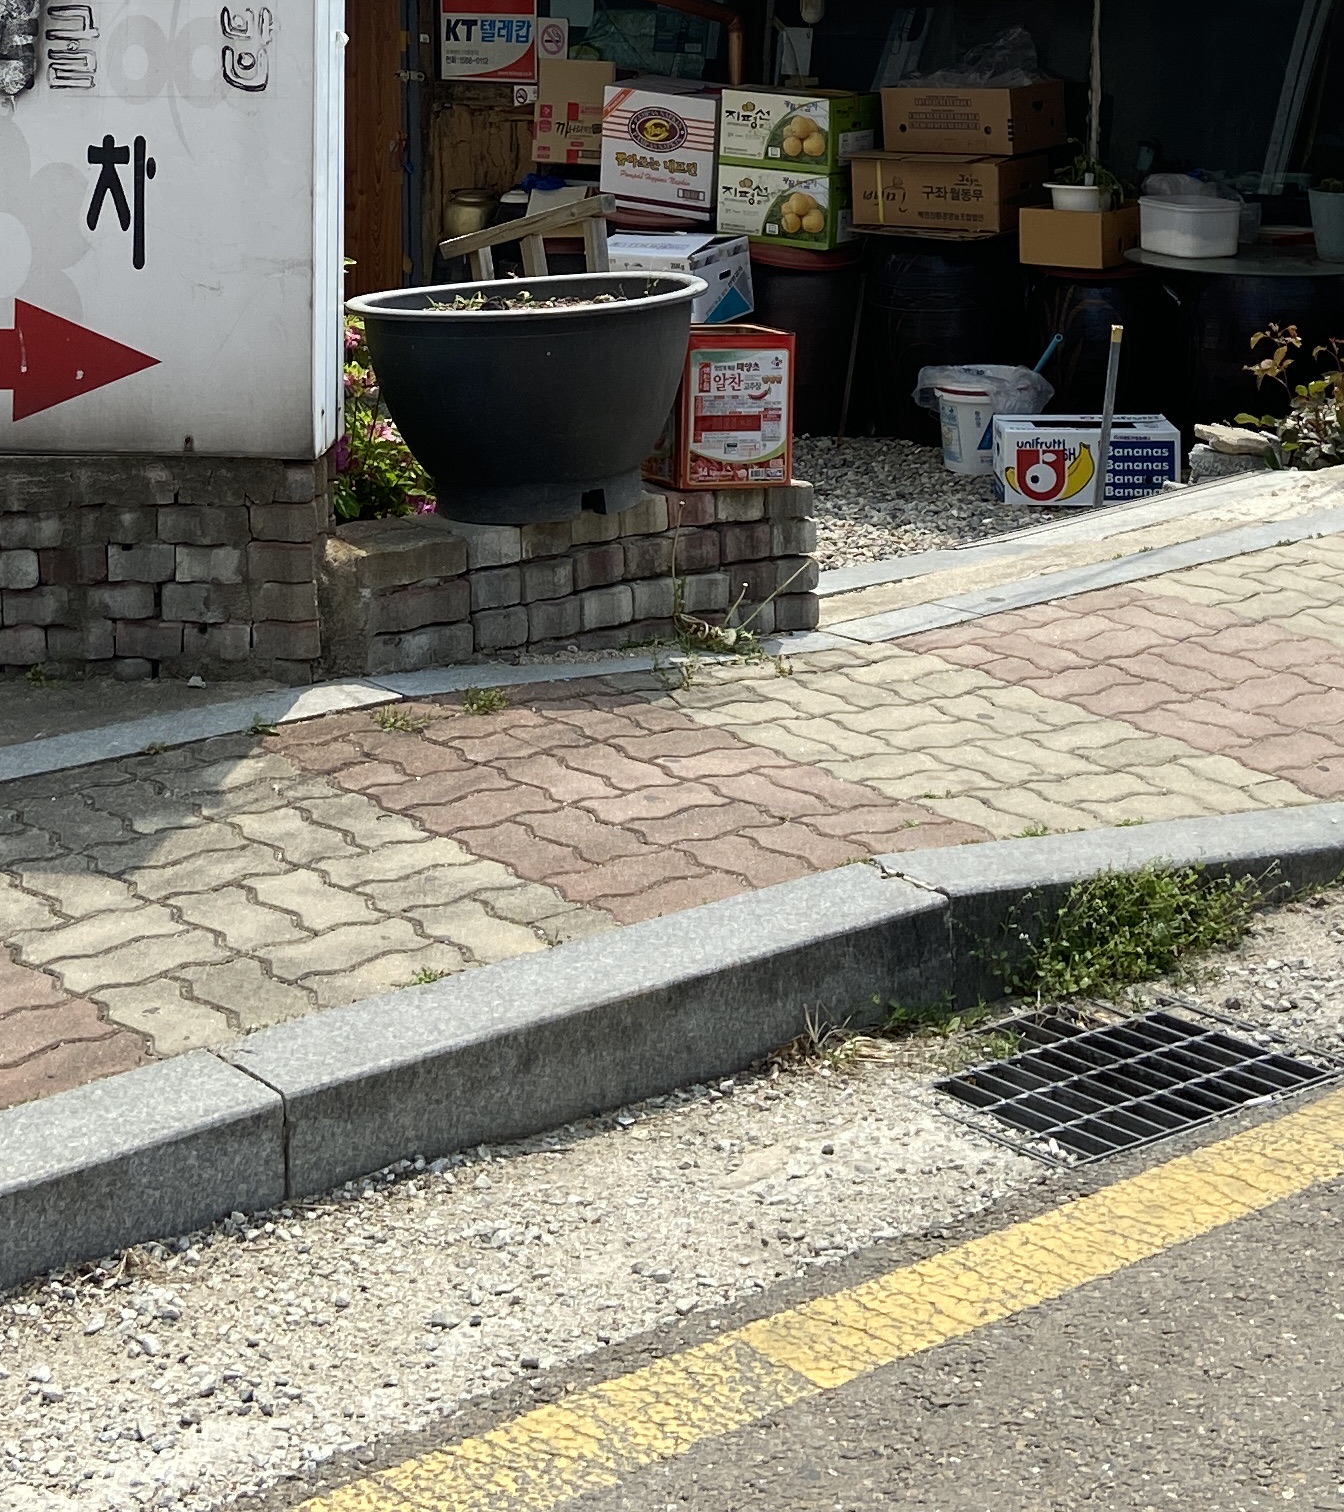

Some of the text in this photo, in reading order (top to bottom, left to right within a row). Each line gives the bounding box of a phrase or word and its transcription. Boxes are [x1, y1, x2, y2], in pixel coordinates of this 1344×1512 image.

[724, 109, 771, 130] 지평선
[721, 185, 770, 206] 지평선
[713, 372, 744, 392] 알찬
[1106, 459, 1170, 470] Bananas
[1105, 472, 1170, 484] Banaas
